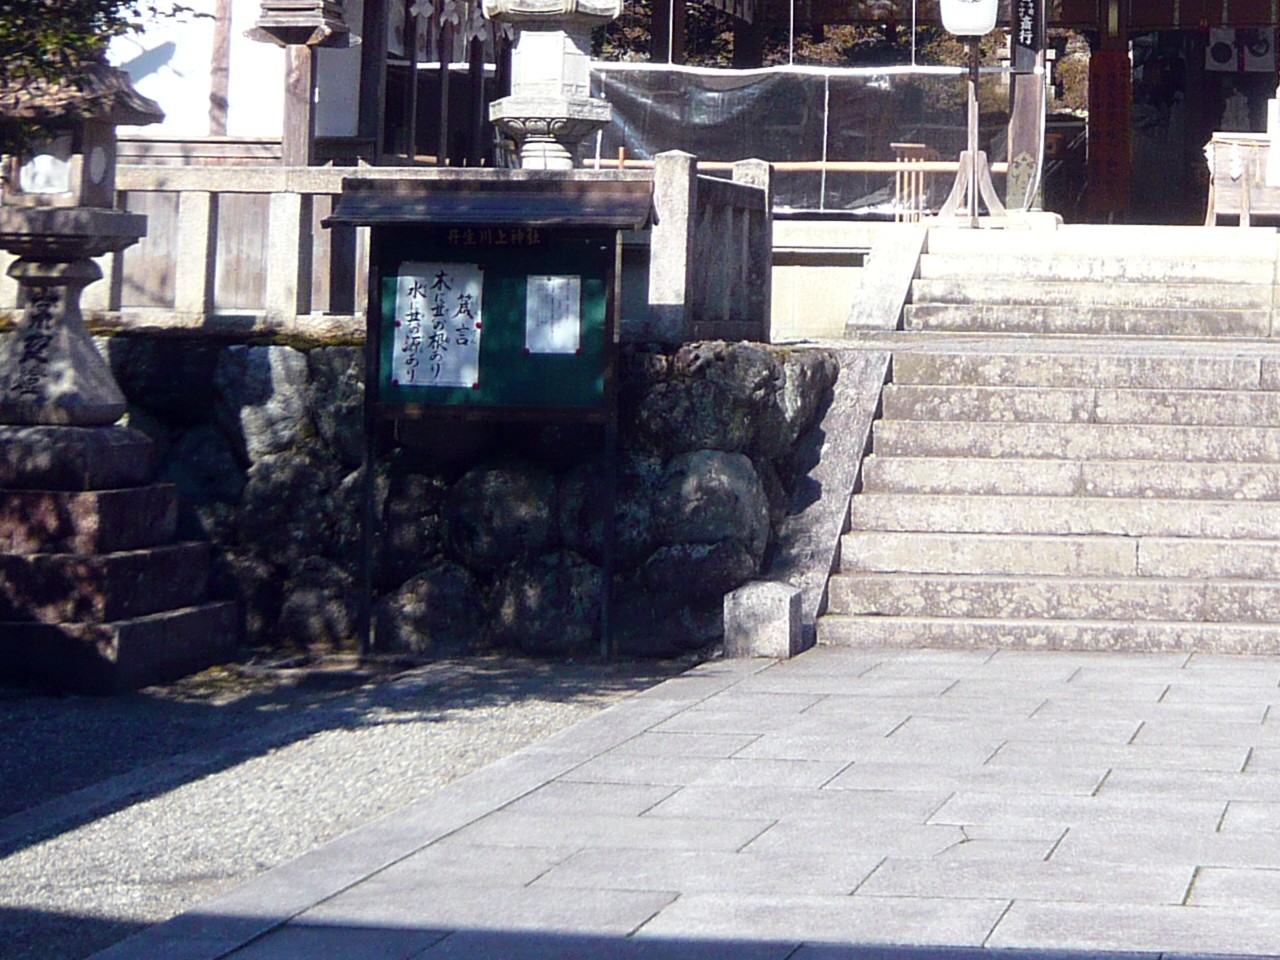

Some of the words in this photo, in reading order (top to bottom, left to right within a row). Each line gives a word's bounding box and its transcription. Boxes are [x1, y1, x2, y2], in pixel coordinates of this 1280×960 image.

[447, 228, 541, 246] 丹生川上神社
